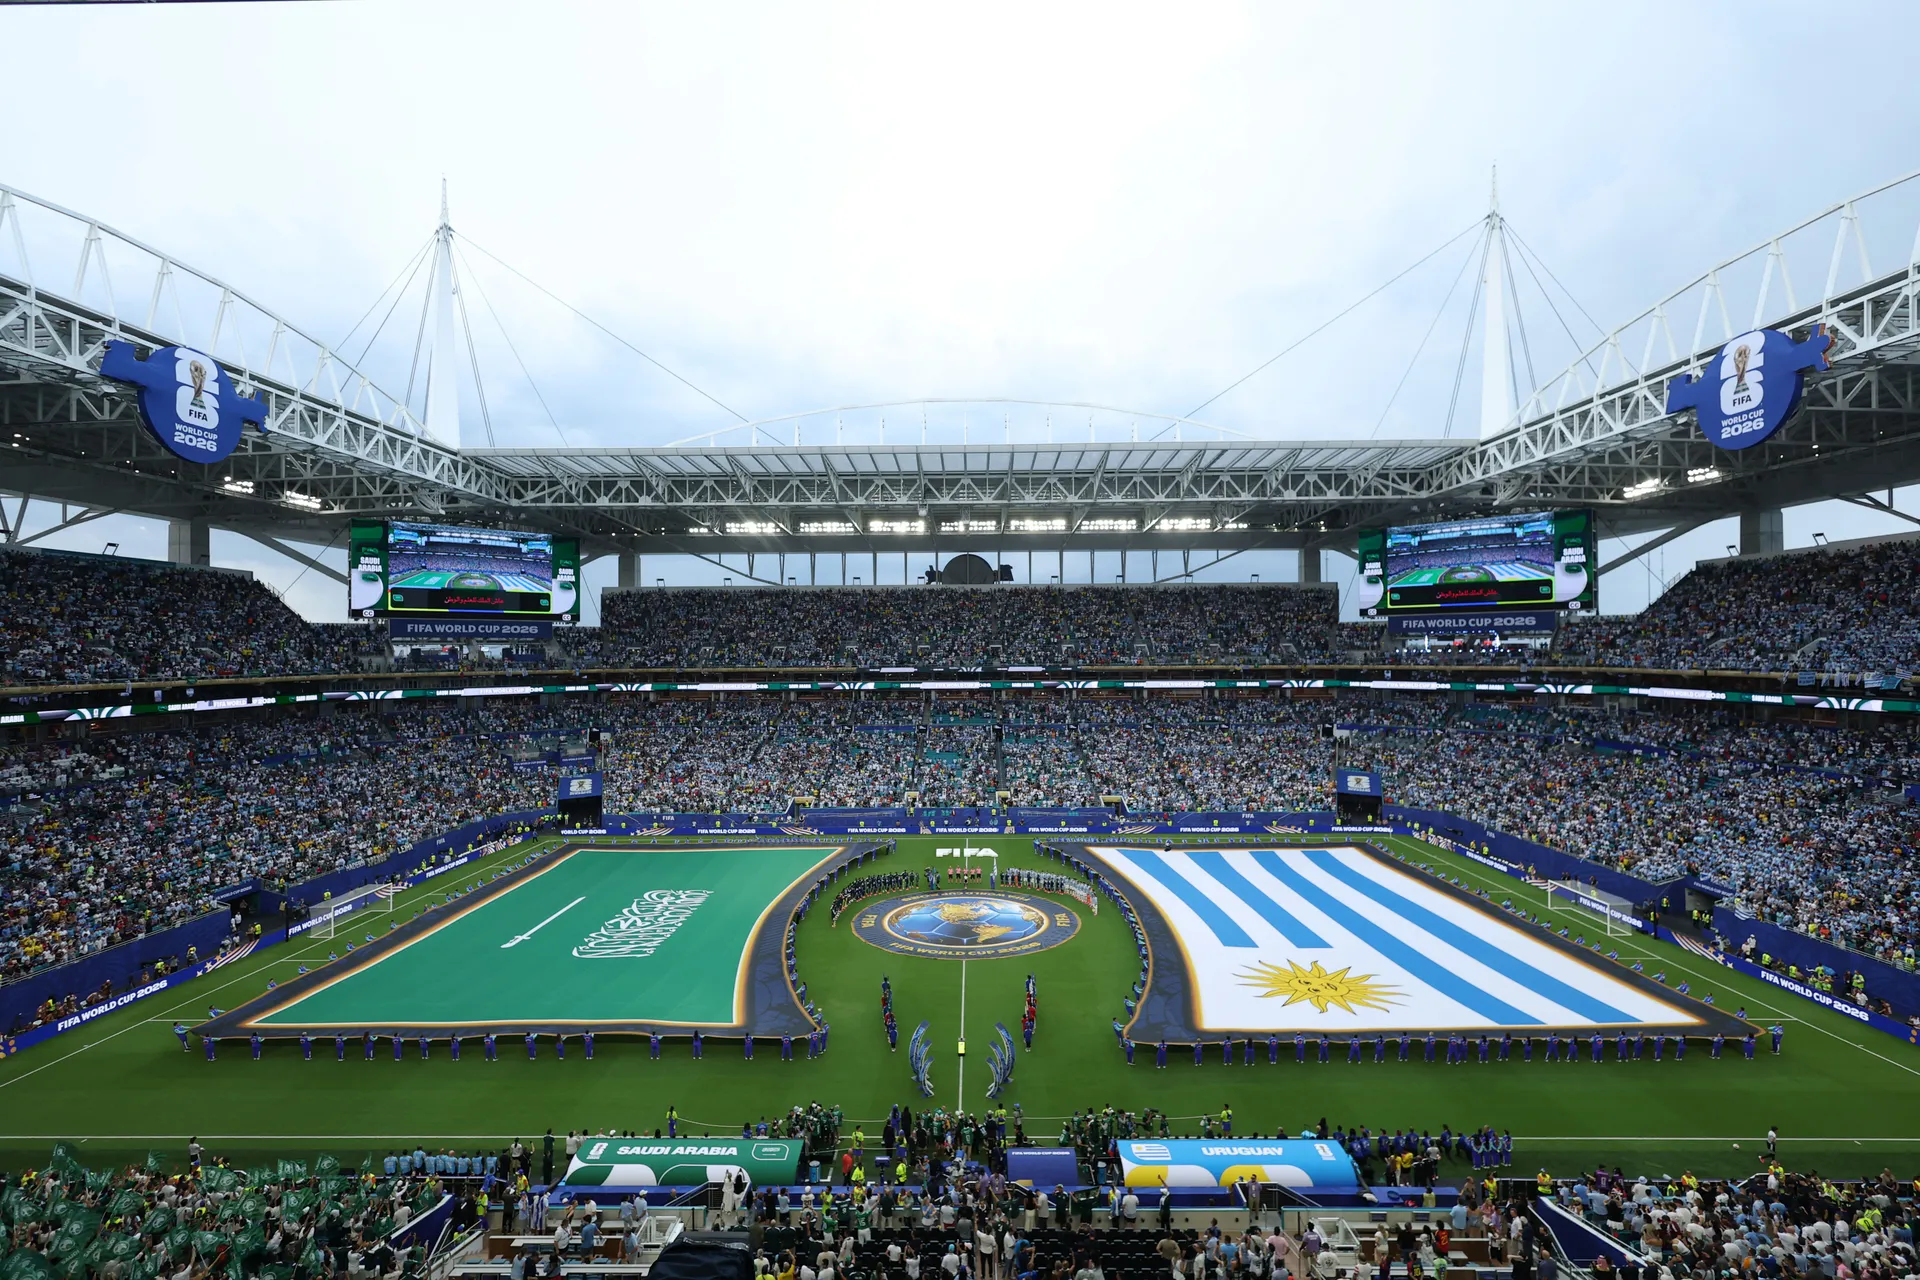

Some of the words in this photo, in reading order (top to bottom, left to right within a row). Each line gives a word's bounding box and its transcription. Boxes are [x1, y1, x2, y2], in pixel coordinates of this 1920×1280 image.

[1733, 395, 1752, 407] FIFA
[188, 409, 208, 422] FIFA
[1721, 414, 1748, 427] WORLD
[1749, 409, 1764, 419] CUP
[175, 423, 202, 437] WORLD
[203, 431, 218, 441] CUP
[1721, 418, 1764, 440] 2026
[174, 432, 217, 452] 2026
[1563, 547, 1583, 556] SAUDI
[360, 556, 380, 564] SAUDI
[1561, 554, 1586, 563] ARABIA
[358, 564, 382, 572] ARABIA
[407, 624, 433, 632] FIFA
[434, 624, 476, 632] WORLD
[478, 624, 500, 633] CUP
[501, 625, 538, 633] 2026
[1402, 620, 1425, 628] FIFA
[1427, 618, 1466, 628] WORLD
[1468, 618, 1491, 626] CUP
[1493, 617, 1536, 626] 2026
[936, 848, 998, 857] FIFA
[1580, 897, 1590, 906] FIFA
[1611, 909, 1622, 919] CUP
[1622, 914, 1642, 928] 2026
[289, 925, 301, 935] FIFA
[302, 917, 322, 930] WORLD
[334, 904, 352, 916] 2026
[861, 914, 878, 928] FIFA
[1054, 913, 1070, 926] FIFA
[890, 942, 914, 951] FIFA
[917, 947, 966, 956] WORLD
[1761, 971, 1779, 984] FIFA
[1780, 978, 1812, 997] WORLD
[1813, 993, 1832, 1005] CUP
[1833, 1001, 1869, 1021] 2026
[58, 1016, 80, 1031] FIFA
[81, 1000, 116, 1020] WORLD
[118, 992, 136, 1006] CUP
[137, 979, 167, 998] 2026
[617, 1146, 671, 1155] SAUDI
[671, 1147, 738, 1156] ARABIA
[1201, 1146, 1284, 1156] URUGUAY
